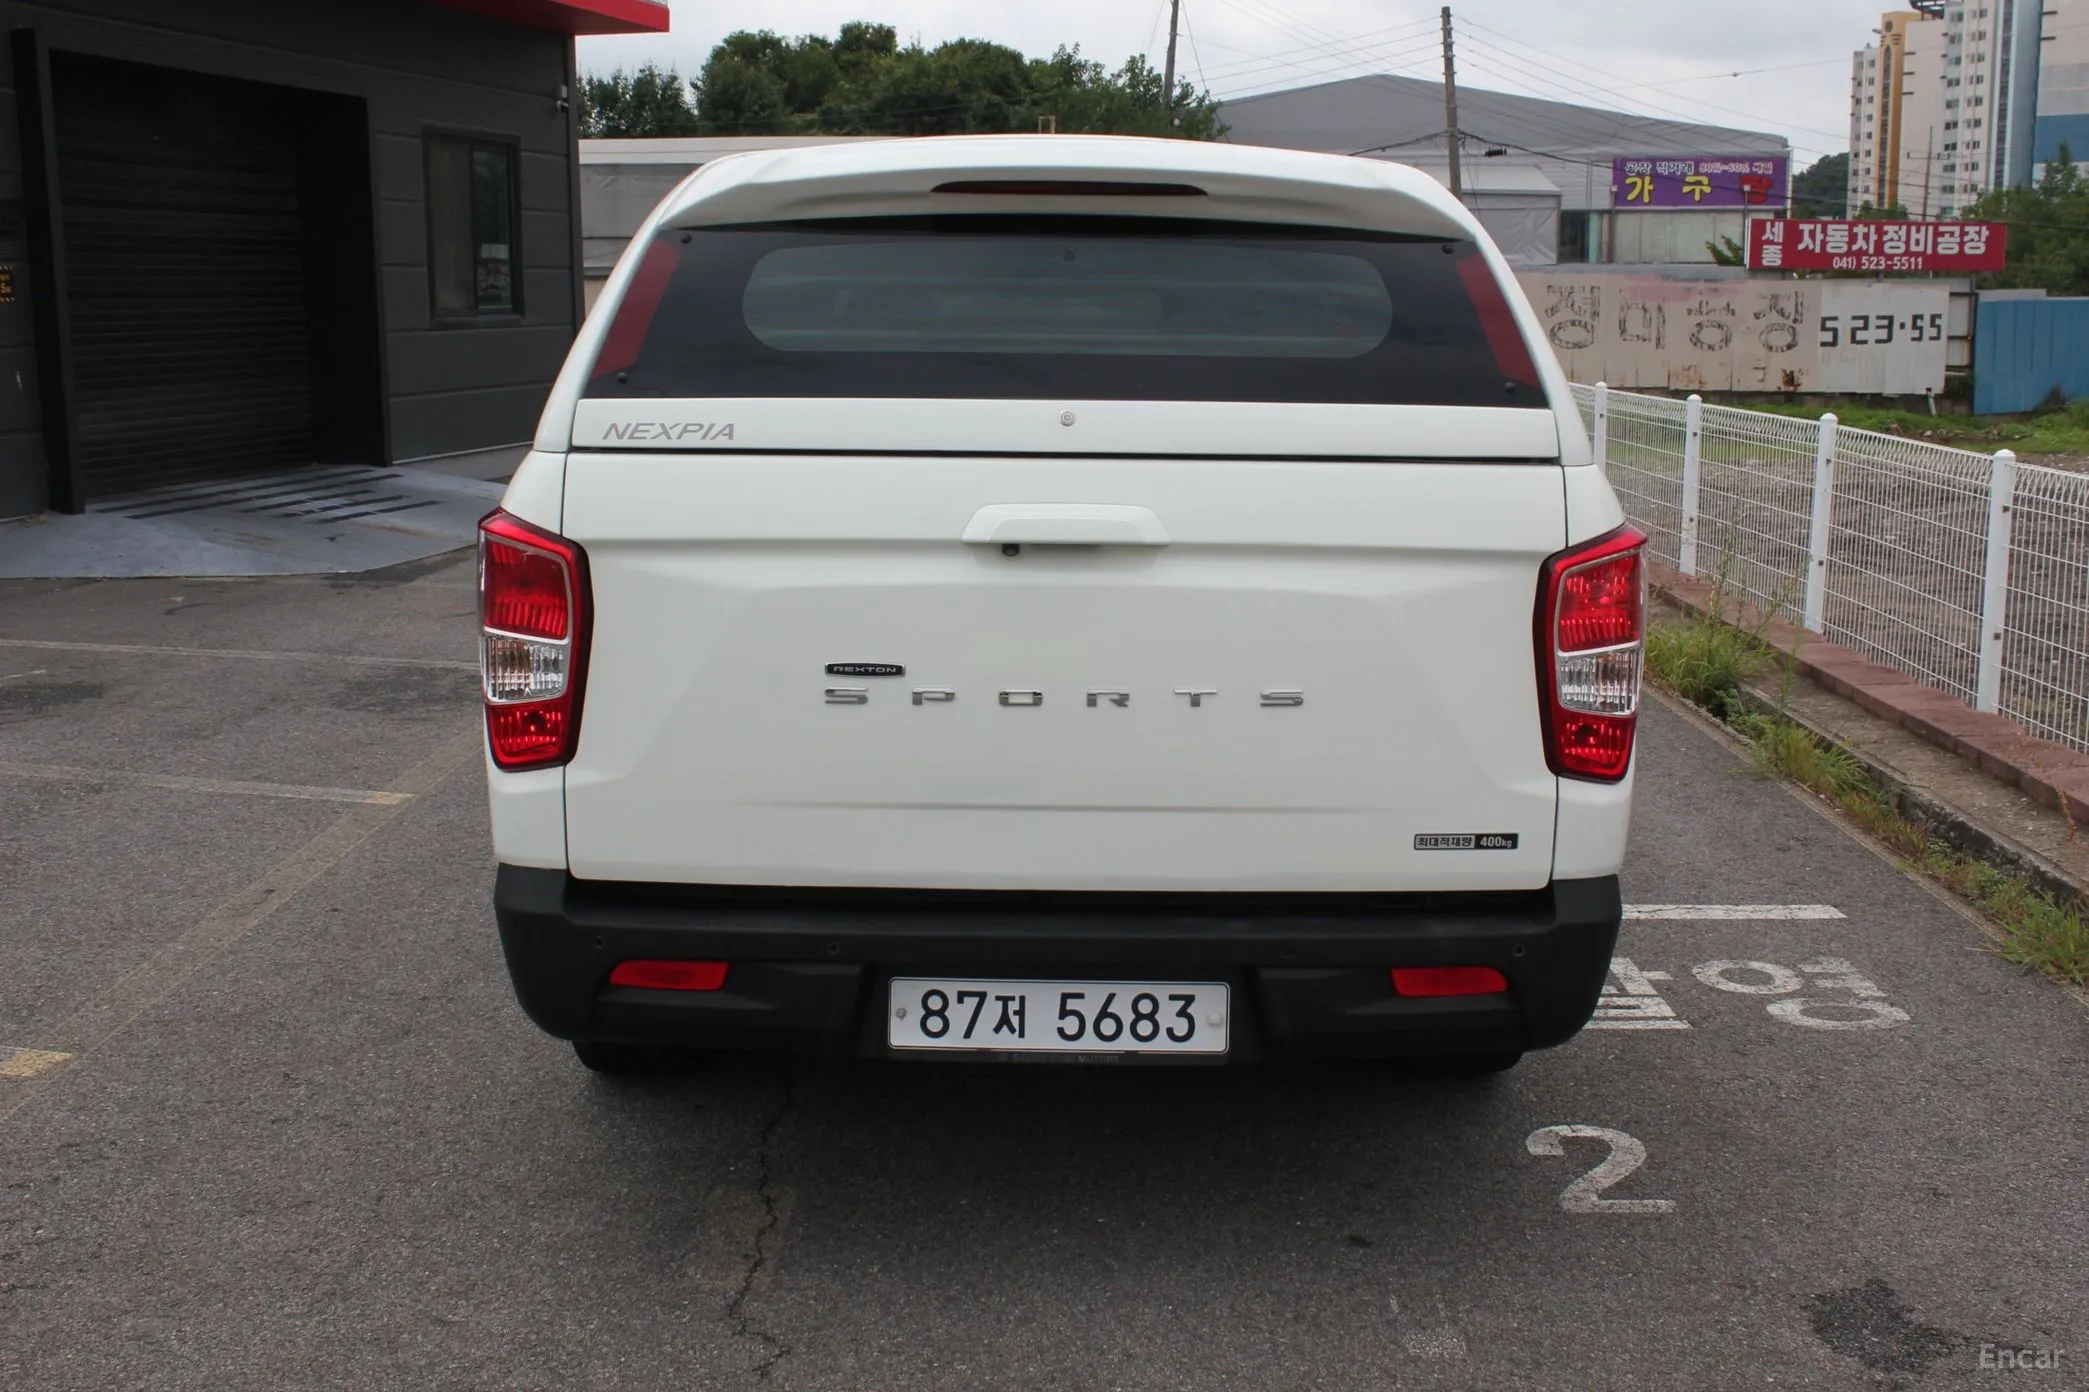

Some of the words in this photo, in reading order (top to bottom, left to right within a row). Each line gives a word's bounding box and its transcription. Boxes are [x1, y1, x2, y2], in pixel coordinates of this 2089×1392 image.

[1656, 161, 1694, 175] 직거래
[1761, 221, 1784, 267] 세종
[1832, 257, 1857, 270] 041)
[1861, 256, 1923, 270] 523-5511
[602, 422, 735, 441] NEXPIA
[824, 686, 1305, 708] SPORTS
[1480, 836, 1512, 848] 400kg
[919, 988, 1027, 1040] 87저
[1056, 991, 1197, 1043] 5683
[1525, 1124, 1677, 1214] 2
